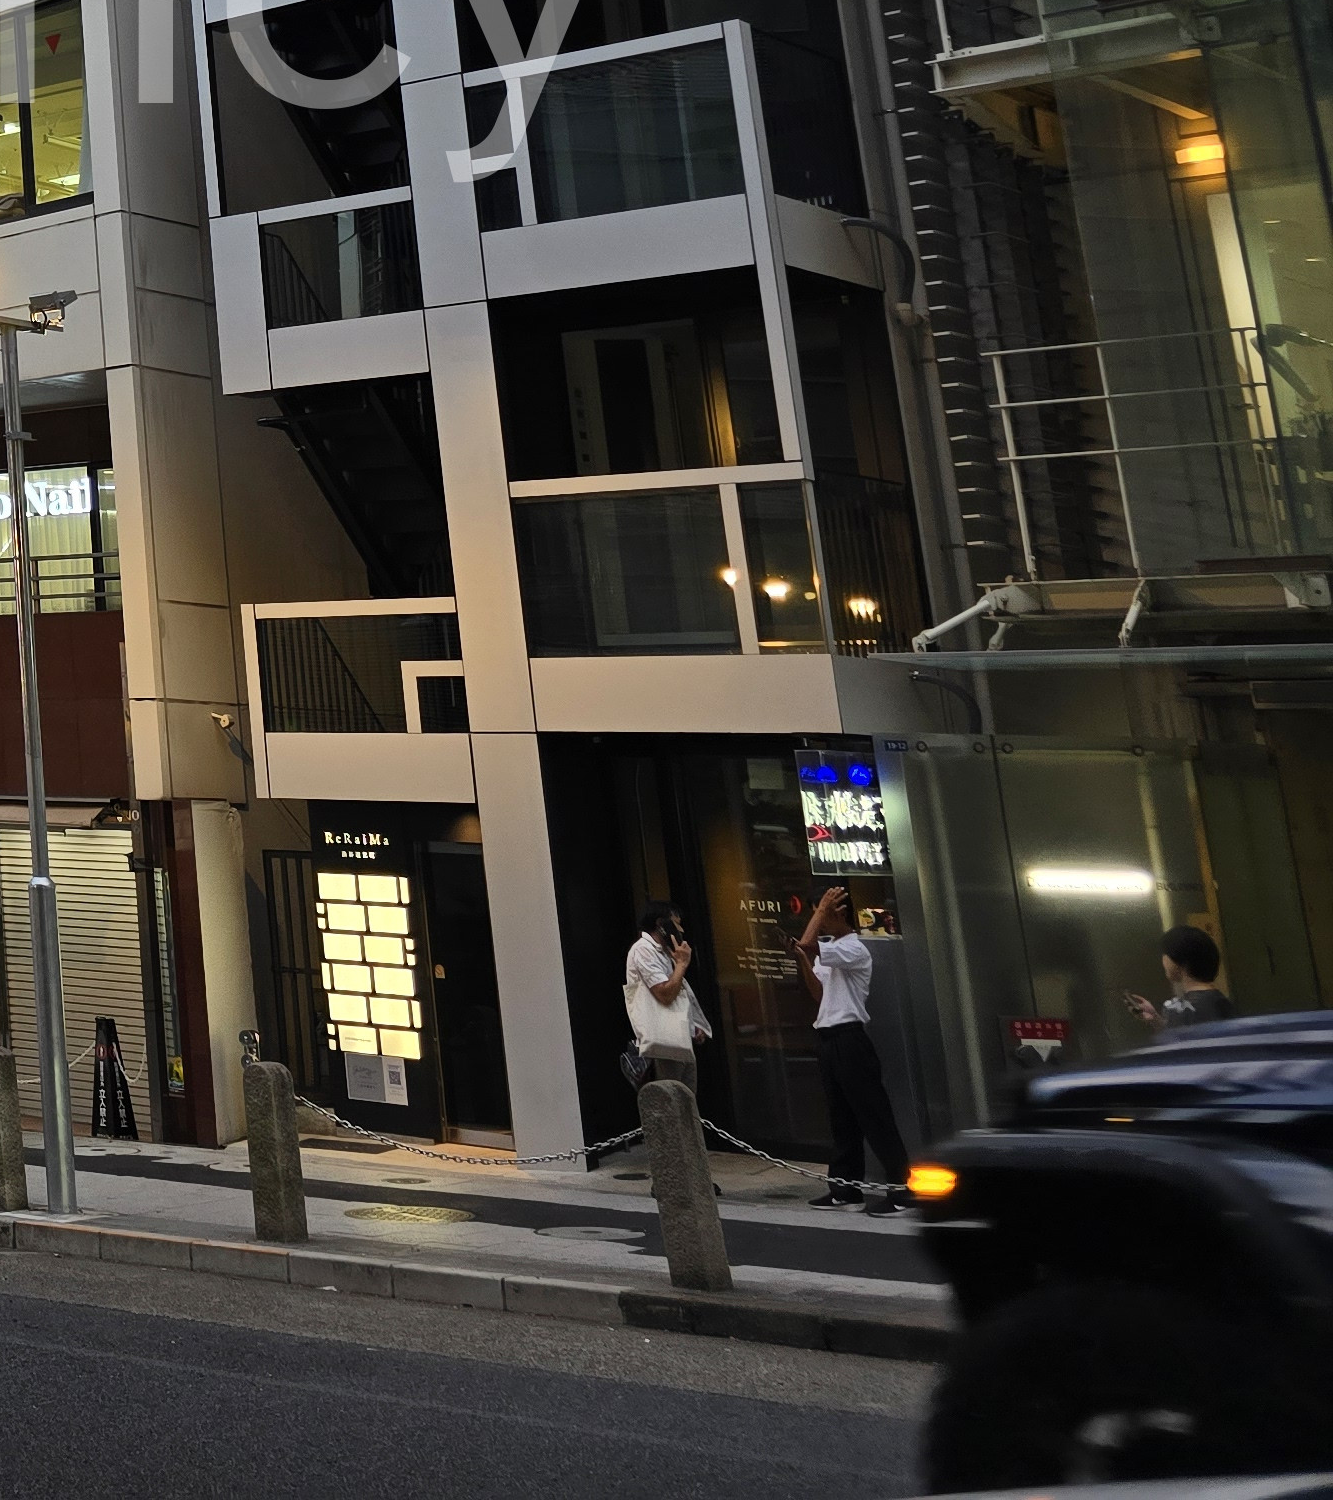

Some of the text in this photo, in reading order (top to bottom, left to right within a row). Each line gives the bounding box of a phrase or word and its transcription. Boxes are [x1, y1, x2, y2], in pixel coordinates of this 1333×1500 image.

[25, 476, 92, 518] Nail
[886, 742, 907, 750] 19-12
[740, 899, 781, 913] AFURI
